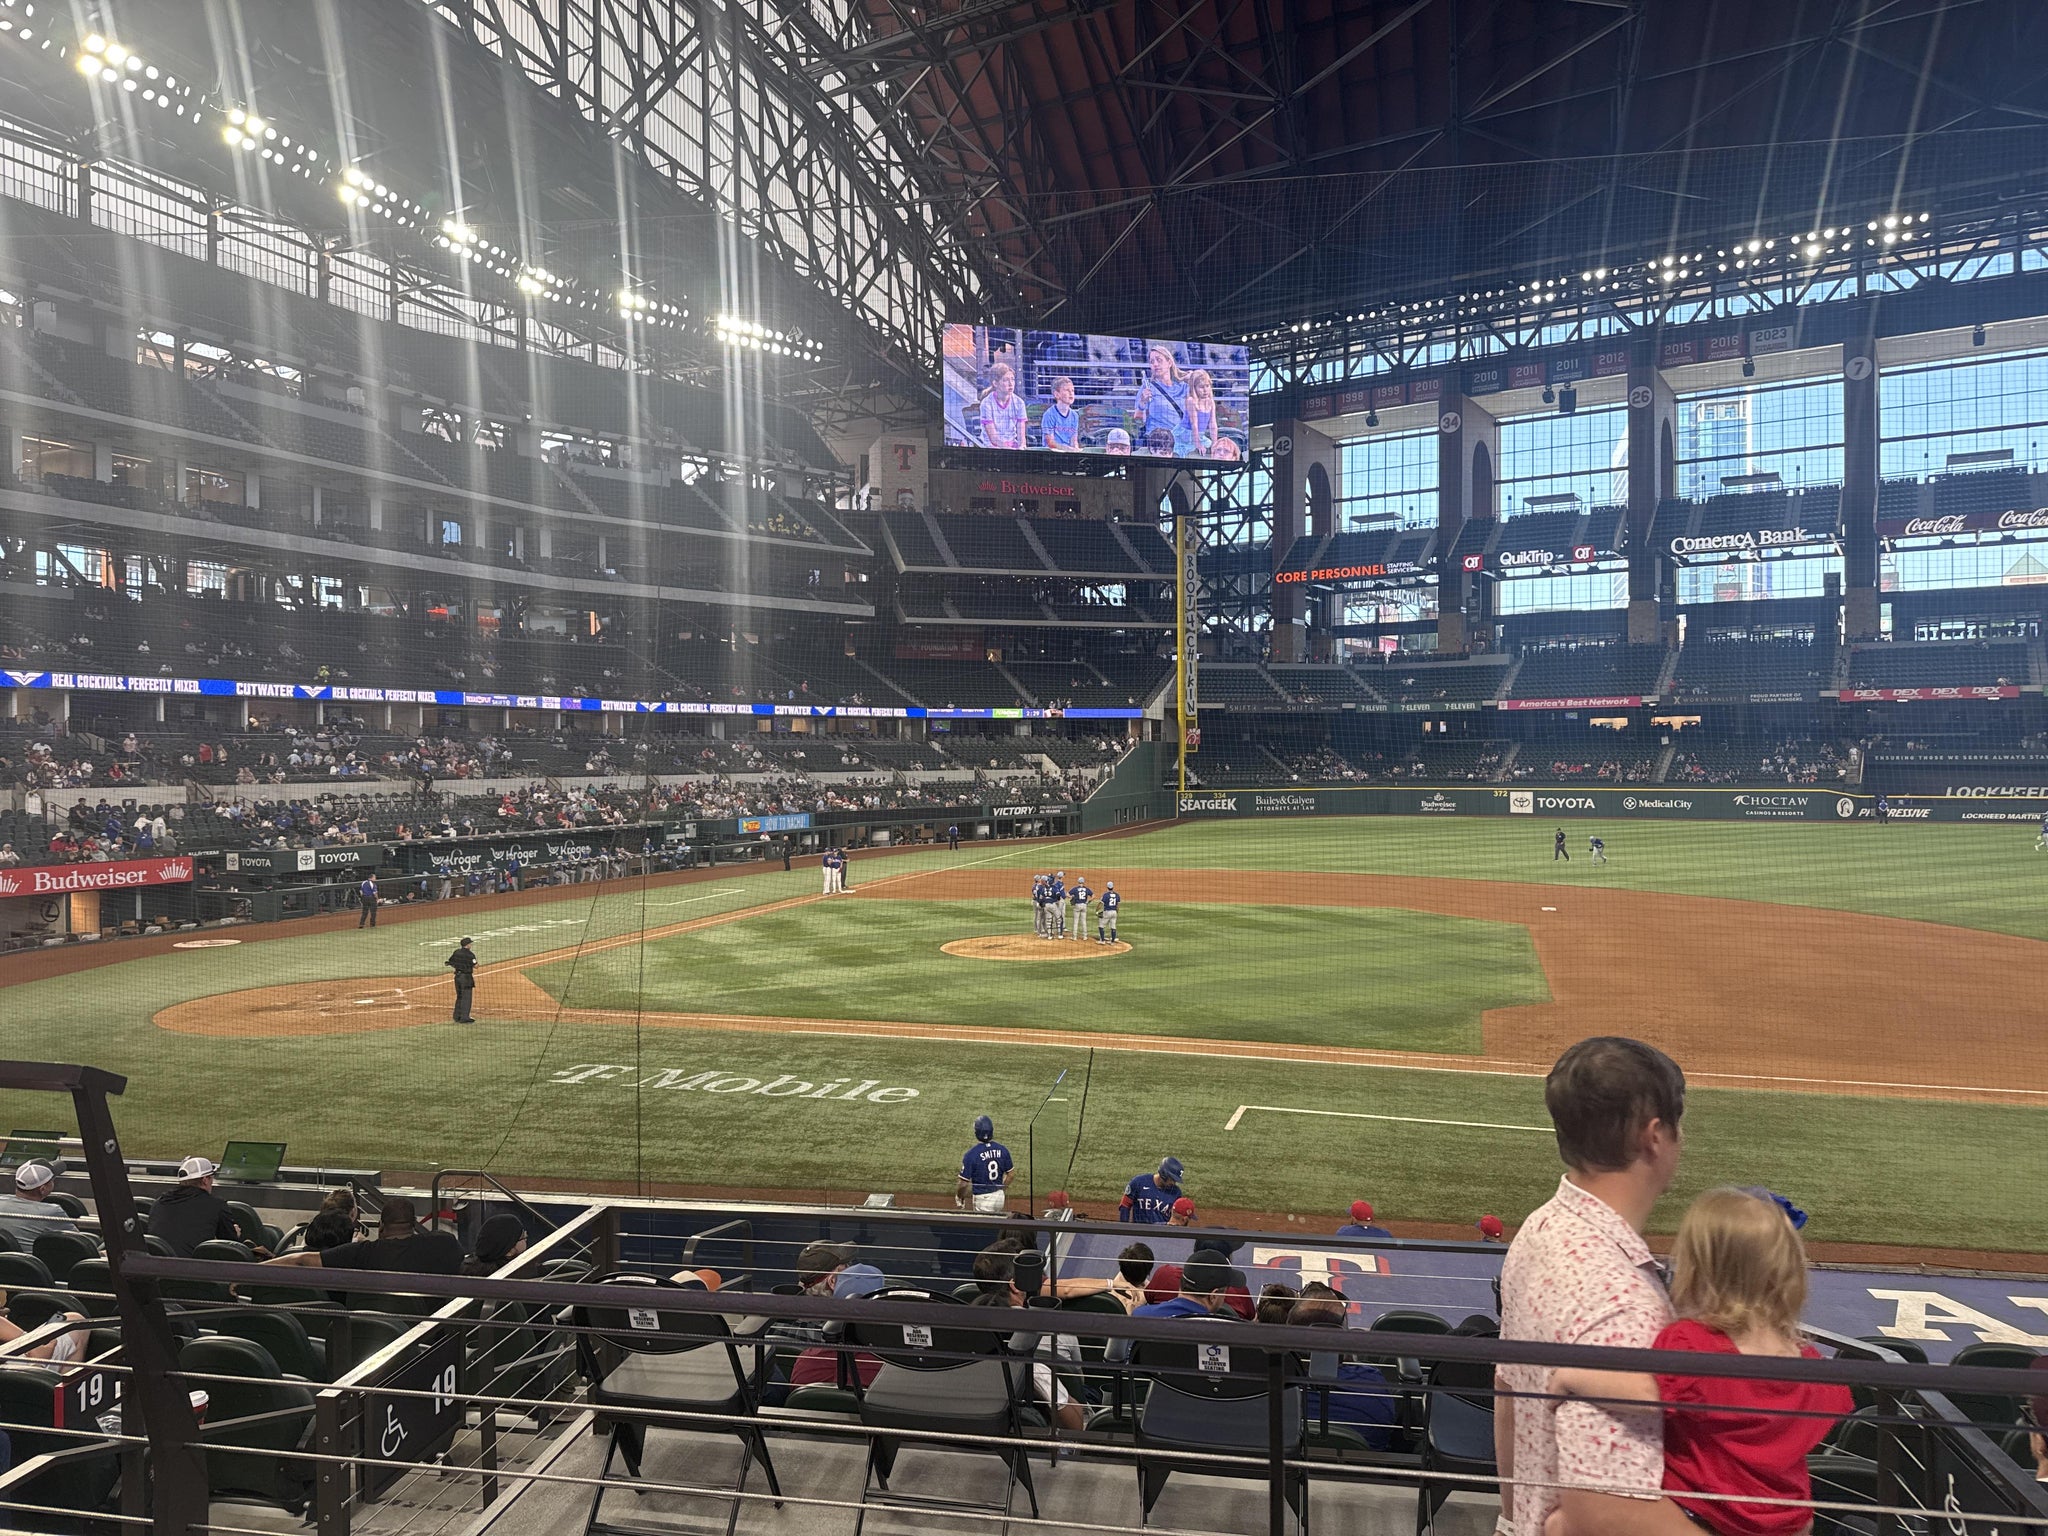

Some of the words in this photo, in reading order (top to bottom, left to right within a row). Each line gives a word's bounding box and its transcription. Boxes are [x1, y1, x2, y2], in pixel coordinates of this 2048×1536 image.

[1755, 328, 1787, 341] 2023
[1711, 335, 1739, 348] 2016
[1664, 342, 1692, 355] 2015
[1599, 352, 1625, 365] 2012
[1516, 365, 1538, 377] 2011
[1556, 359, 1579, 371] 2011
[1854, 362, 1864, 375] 7
[1474, 371, 1498, 383] 2010
[1377, 386, 1400, 398] 1999
[1416, 380, 1439, 392] 2010
[1306, 397, 1327, 408] 1996
[1342, 392, 1364, 403] 1998
[1632, 391, 1650, 404] 26
[1442, 417, 1460, 429] 34
[1276, 440, 1290, 451] 42
[1998, 507, 2048, 528] Coca-Co
[1905, 514, 1967, 536] Coca-Cola
[1759, 527, 1807, 545] Bank
[1500, 550, 1553, 565] QuikTrip
[1574, 547, 1591, 560] QT
[1464, 556, 1479, 569] QT
[1275, 570, 1308, 583] CORE
[1311, 564, 1387, 580] PERSONNEL
[52, 673, 75, 687] REAL
[128, 677, 172, 692] PERFECTLY
[236, 683, 295, 697] CUTWATER
[1854, 689, 1881, 697] DEX
[1893, 688, 1920, 696] DEX
[1931, 687, 1959, 695] DEX
[1972, 686, 2000, 694] DEX
[1519, 700, 1565, 708] America's
[1588, 698, 1630, 706] Network
[1180, 798, 1237, 811] SEATGEEK
[1537, 798, 1595, 809] TOYOTA
[1740, 795, 1809, 806] CHOCTAW
[993, 806, 1033, 816] VICTORY
[1858, 808, 1930, 818] PRESSIVE
[241, 858, 271, 867] TOYOTA
[319, 852, 360, 864] TOYOTA
[34, 868, 147, 892] Budweiser
[980, 1150, 1001, 1162] SMITH
[987, 1160, 999, 1181] 8
[1137, 1199, 1171, 1217] TEXA
[77, 1373, 102, 1412] 19
[432, 1364, 455, 1415] 19
